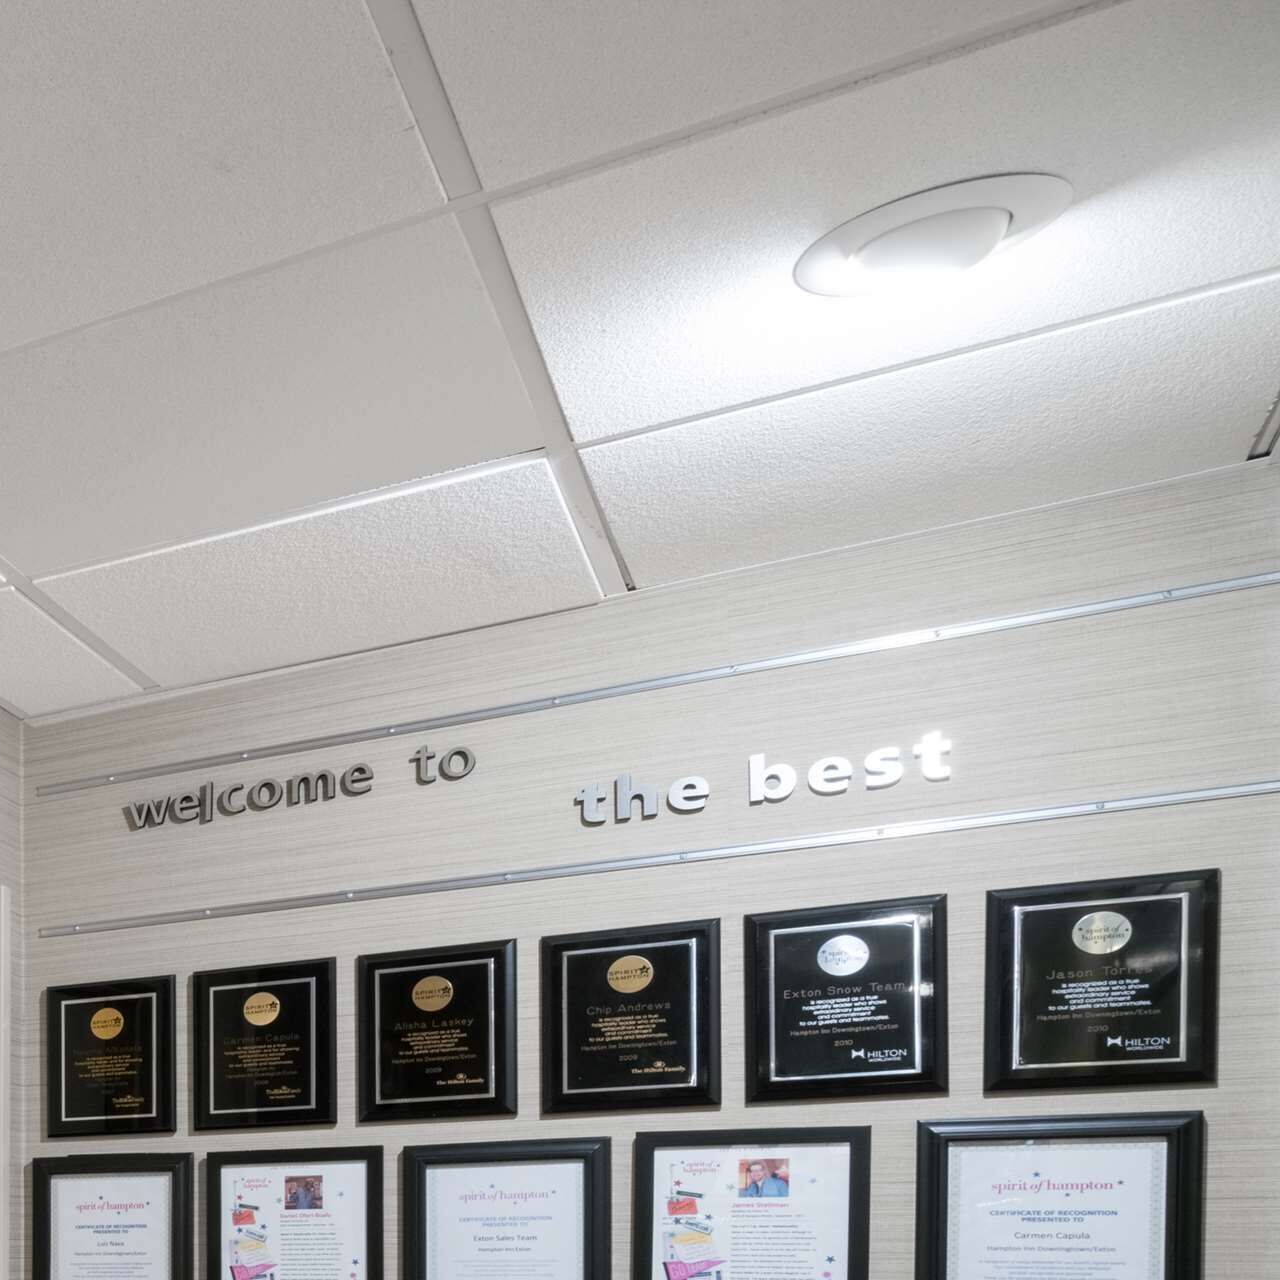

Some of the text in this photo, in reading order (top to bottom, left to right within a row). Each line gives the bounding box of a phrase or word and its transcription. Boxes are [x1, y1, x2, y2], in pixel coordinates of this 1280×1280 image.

[574, 731, 952, 828] the best
[122, 744, 476, 831] welcome to
[1046, 968, 1092, 980] Jason
[784, 982, 905, 999] Exton Snow Team
[1125, 1037, 1170, 1046] HILTON
[868, 1049, 907, 1058] HILTON
[992, 1180, 1113, 1194] spirit of hampton
[1014, 1231, 1090, 1241] Carmen Capula
